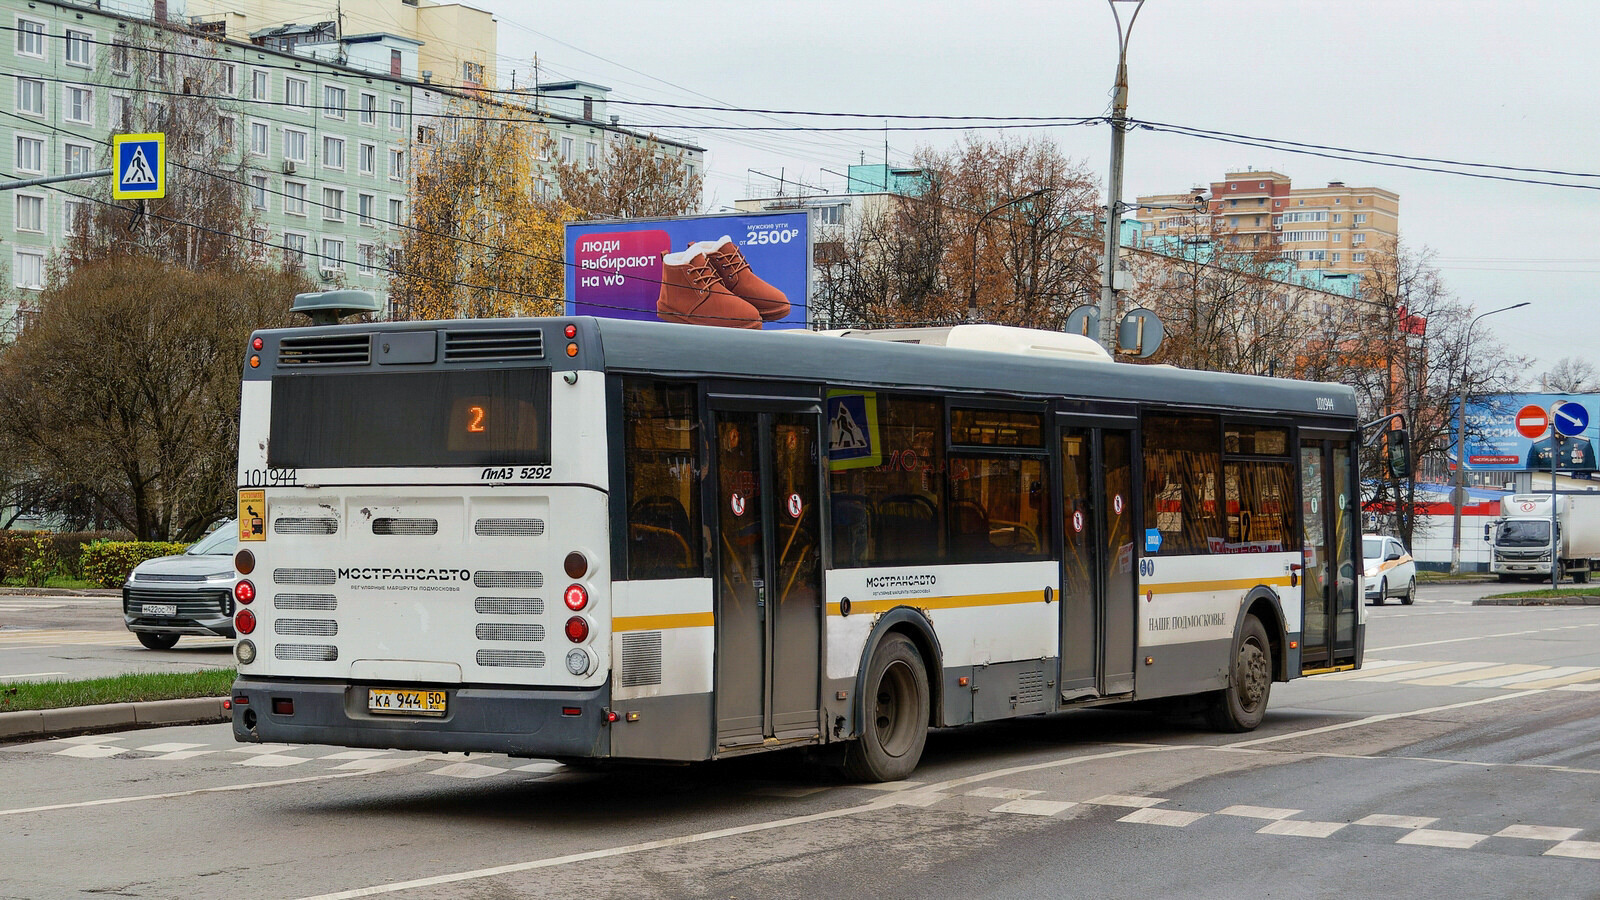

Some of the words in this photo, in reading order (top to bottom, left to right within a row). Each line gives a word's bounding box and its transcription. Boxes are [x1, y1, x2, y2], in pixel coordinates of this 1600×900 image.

[581, 240, 620, 253] люди
[581, 254, 656, 271] выбирают
[581, 276, 599, 287] на
[603, 271, 625, 287] wb
[469, 406, 484, 432] 2
[244, 468, 297, 486] 101944
[520, 467, 552, 479] 5292
[338, 568, 471, 581] МОСТРАНСАВТО
[866, 575, 936, 587] МОСТРАНСАВТО
[1148, 617, 1171, 631] НАШЕ
[1172, 613, 1226, 630] ПОДМОСКОВЬЕ
[375, 695, 390, 708] КА
[397, 692, 421, 708] 944
[428, 692, 441, 704] 50
